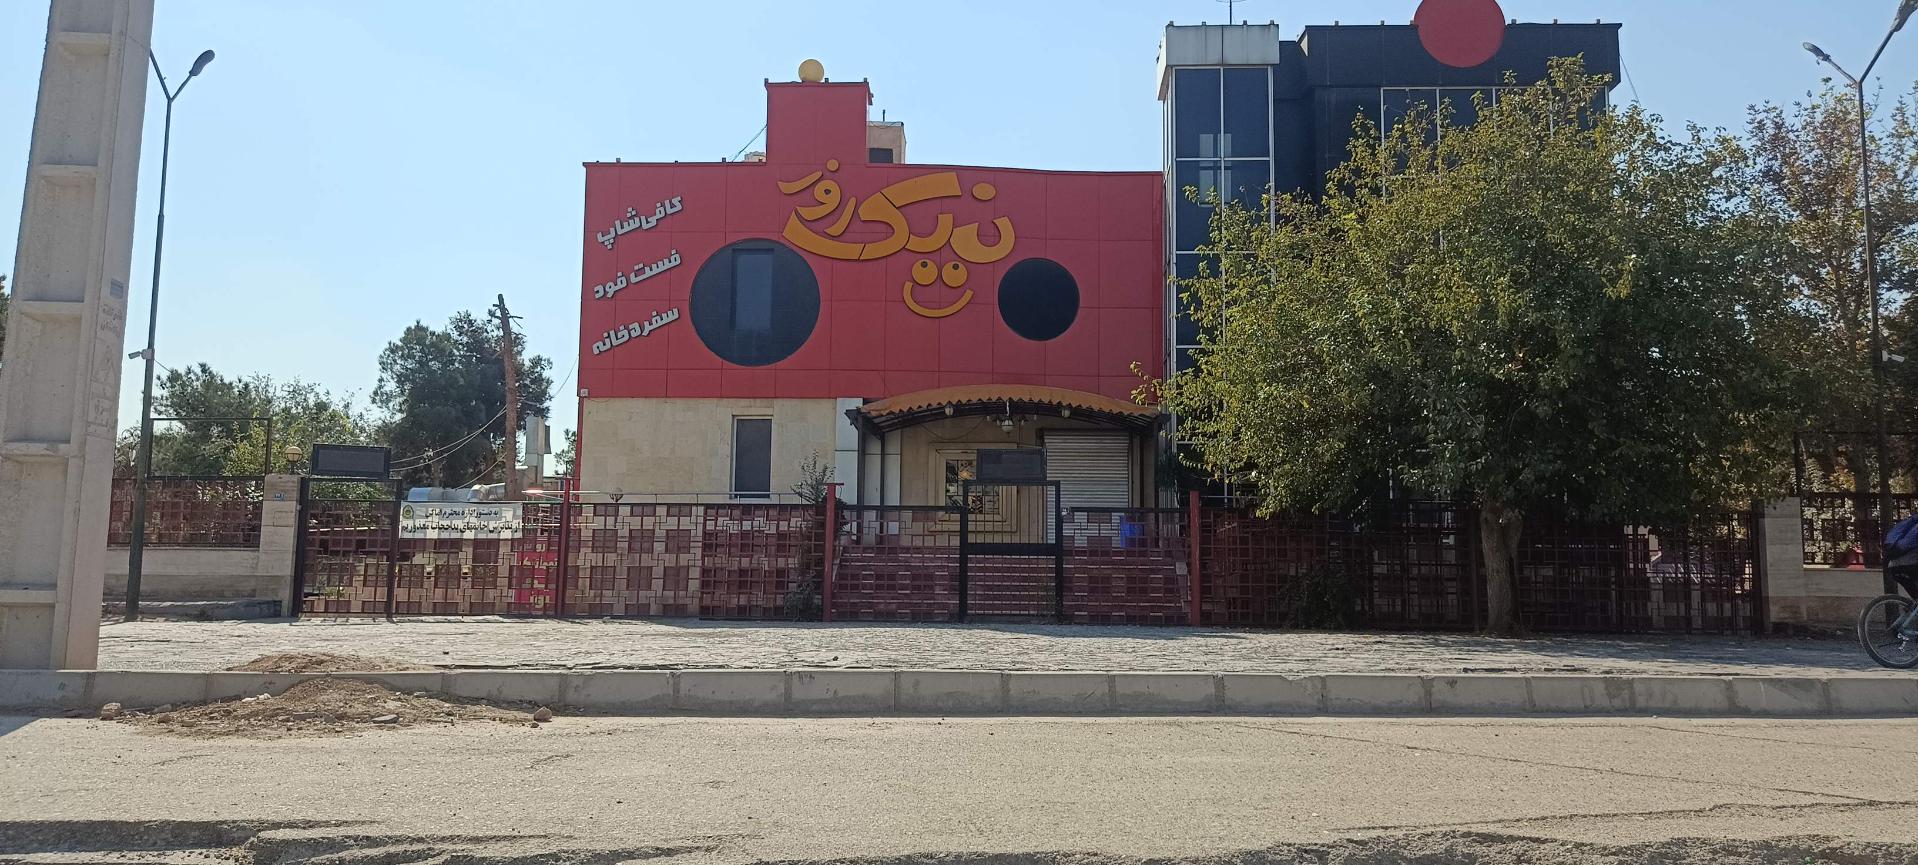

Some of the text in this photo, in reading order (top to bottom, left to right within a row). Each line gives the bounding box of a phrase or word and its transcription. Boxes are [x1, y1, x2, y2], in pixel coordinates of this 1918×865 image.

[594, 249, 681, 299] فست فود
[442, 509, 461, 519] محترم
[401, 520, 431, 534] معذوریم
[489, 520, 513, 534] پذیرش
